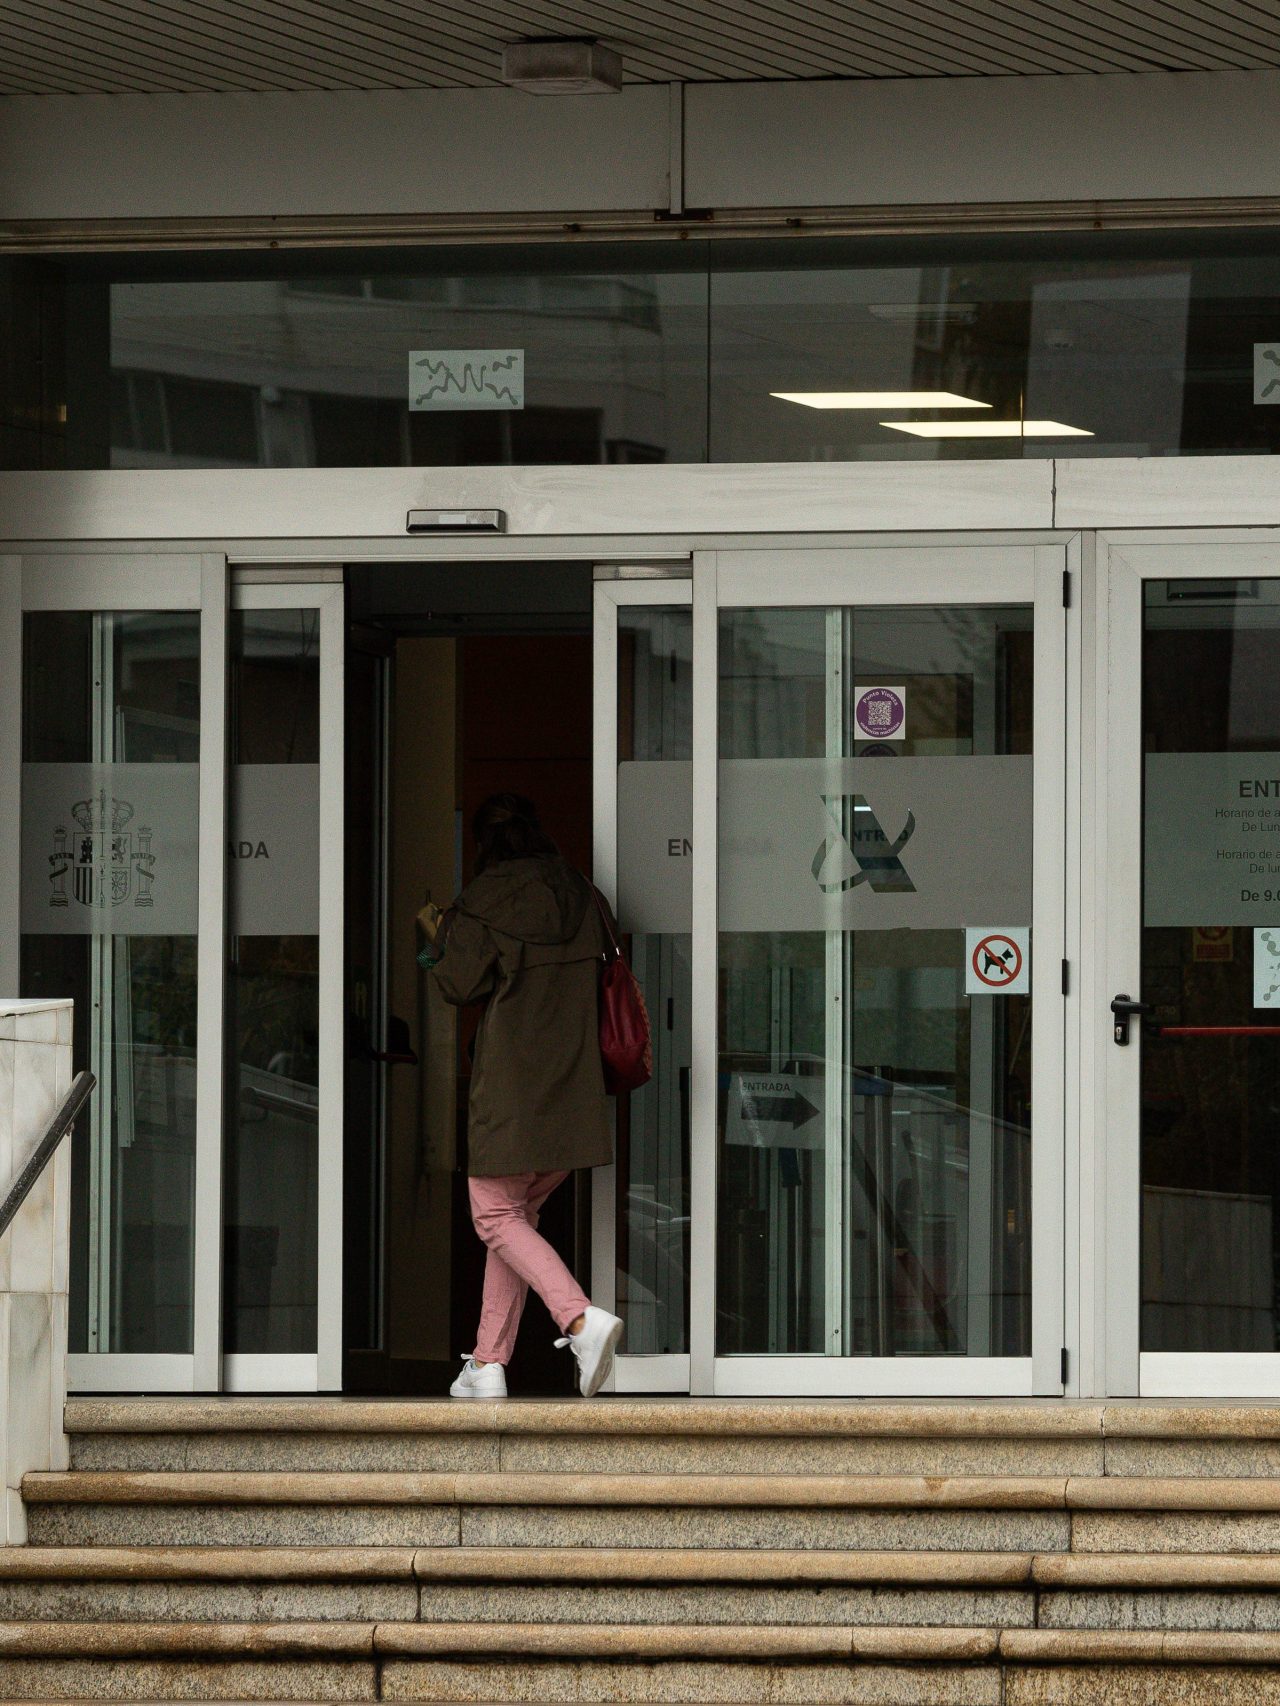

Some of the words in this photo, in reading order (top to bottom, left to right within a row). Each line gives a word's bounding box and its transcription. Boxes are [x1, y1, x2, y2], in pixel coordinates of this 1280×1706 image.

[862, 691, 880, 704] Punto
[1215, 808, 1254, 818] Horario
[1257, 808, 1271, 818] de
[1242, 822, 1257, 832] De
[1216, 850, 1256, 860] Horario
[1259, 849, 1273, 859] de
[1250, 863, 1265, 873] De
[1241, 889, 1260, 901] De
